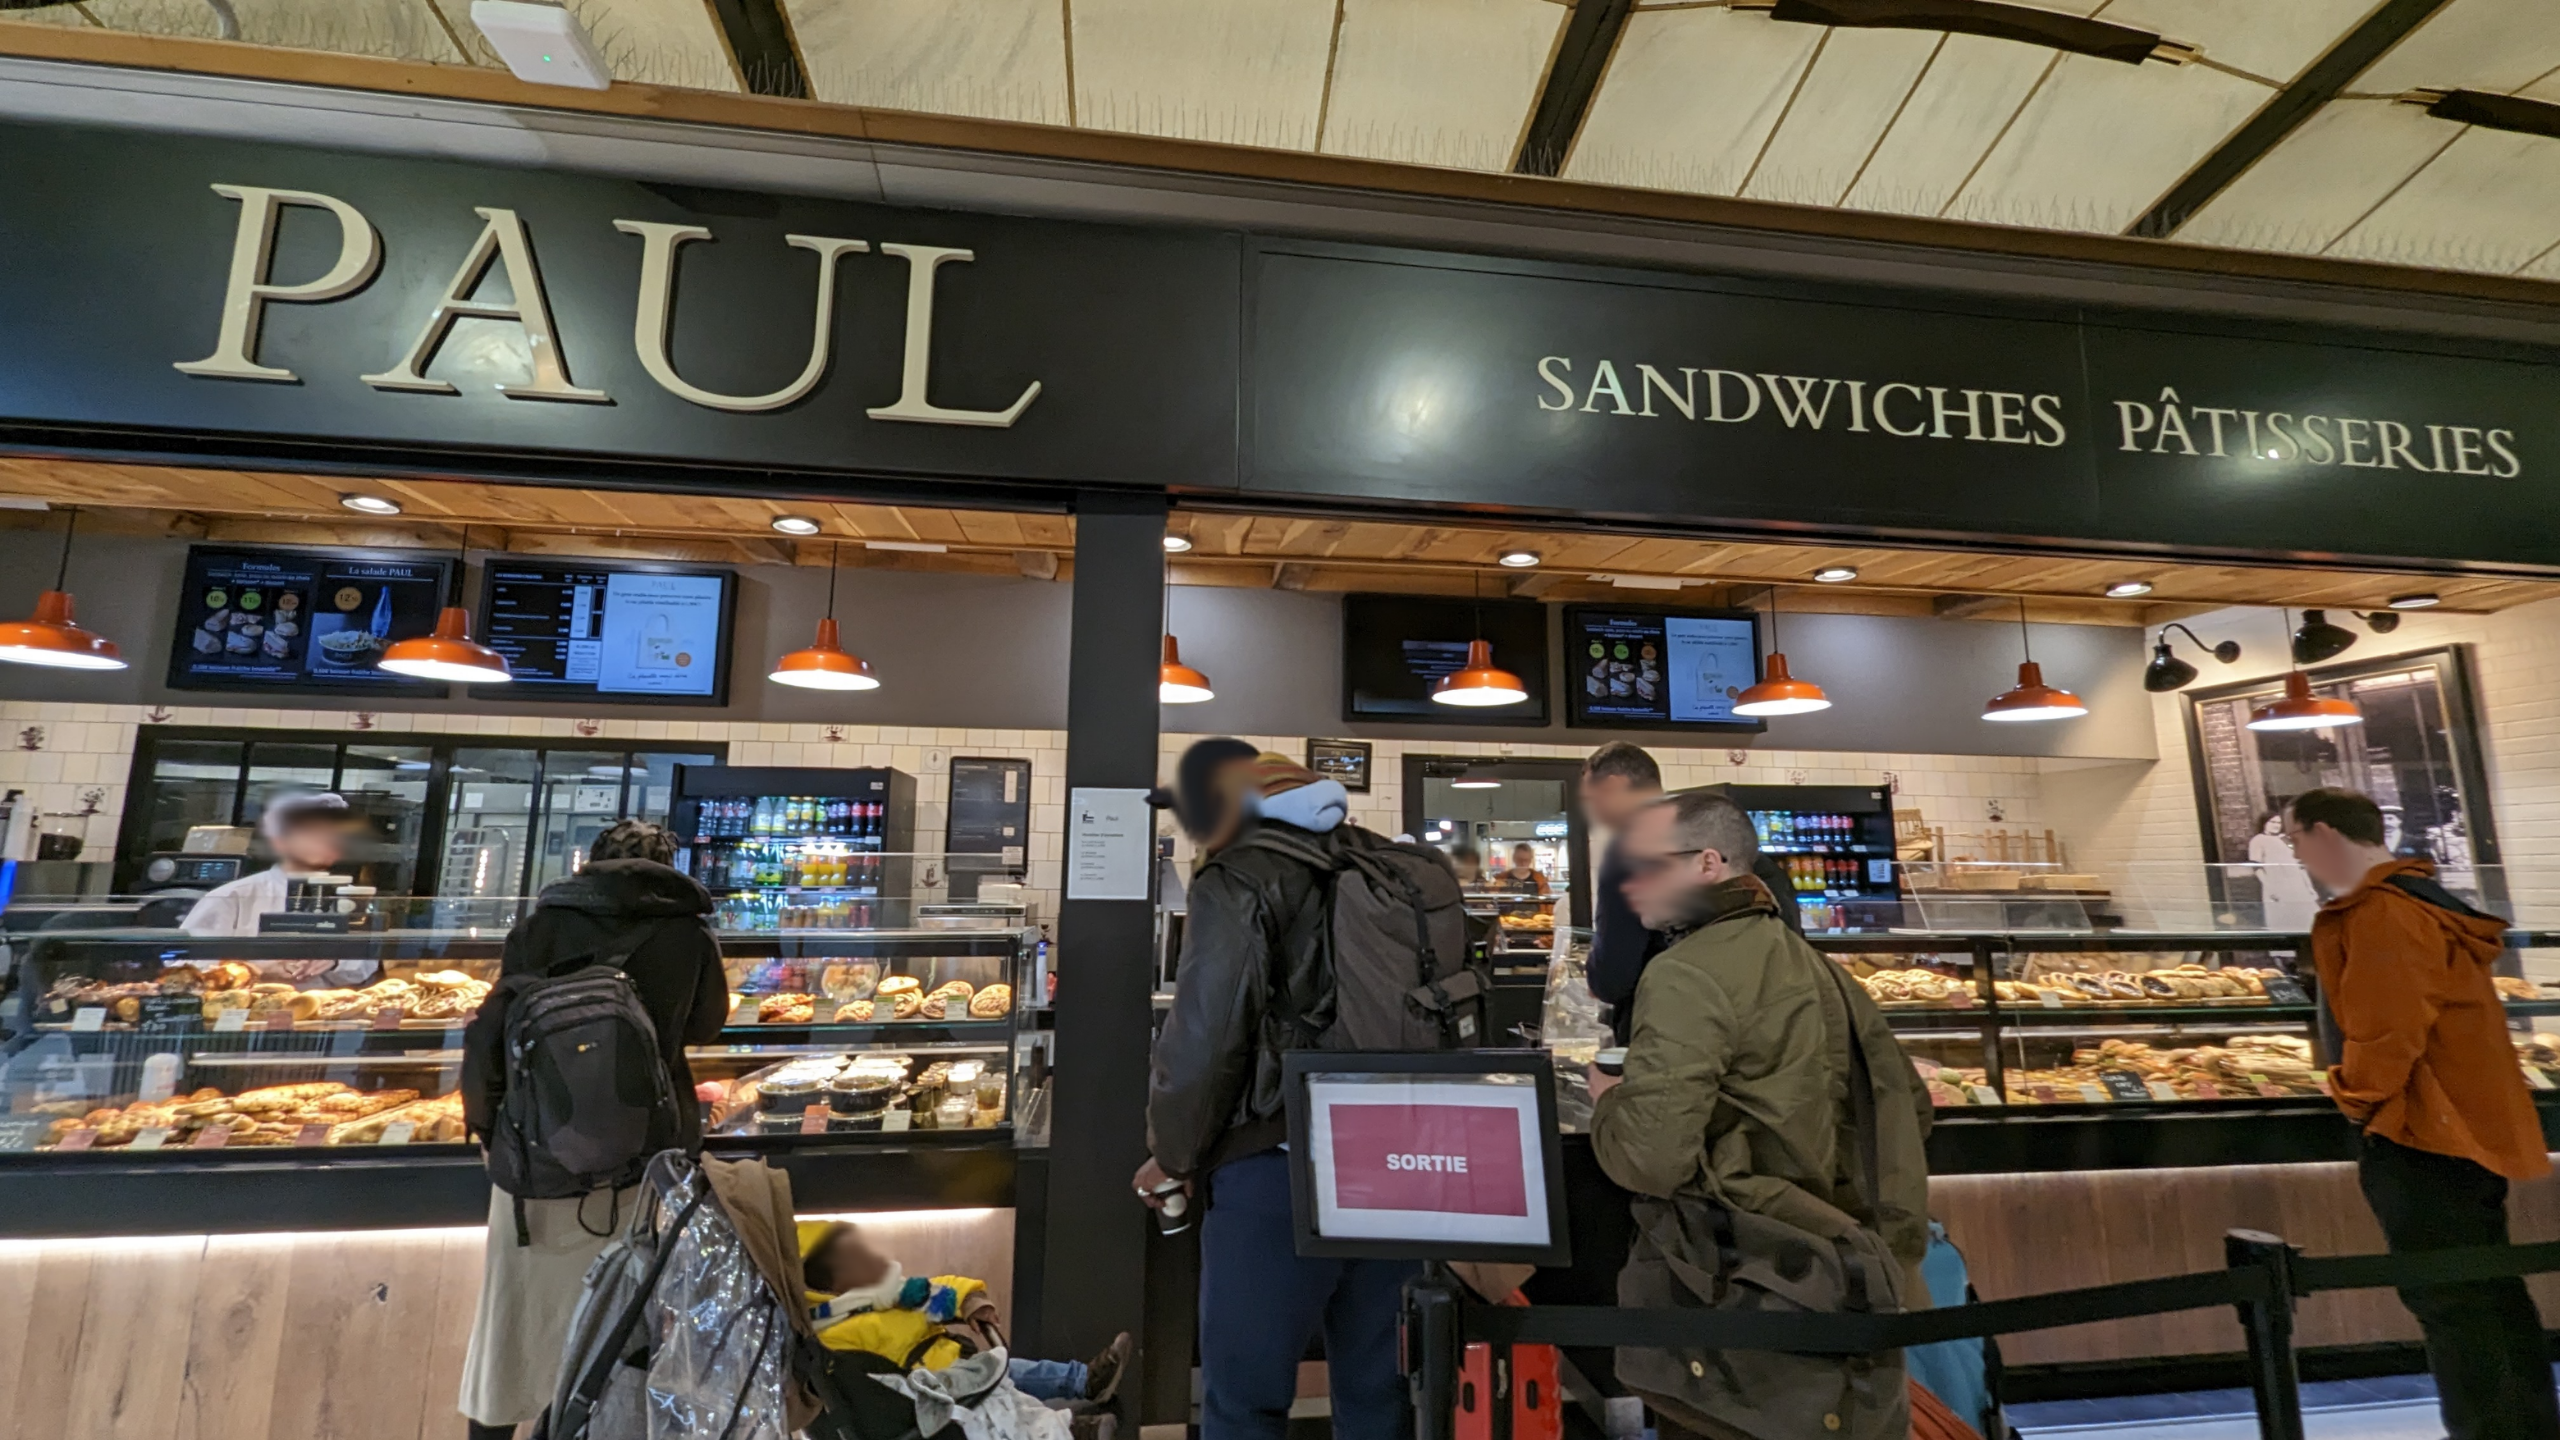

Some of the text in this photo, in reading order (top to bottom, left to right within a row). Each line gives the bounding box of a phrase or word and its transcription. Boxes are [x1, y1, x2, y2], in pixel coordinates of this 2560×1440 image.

[173, 182, 1042, 429] PAUL
[1536, 356, 2521, 479] SANDWICHES PÂTISSERIES
[348, 566, 413, 577] La salade PAUL
[1386, 1153, 1468, 1173] SORTIE
